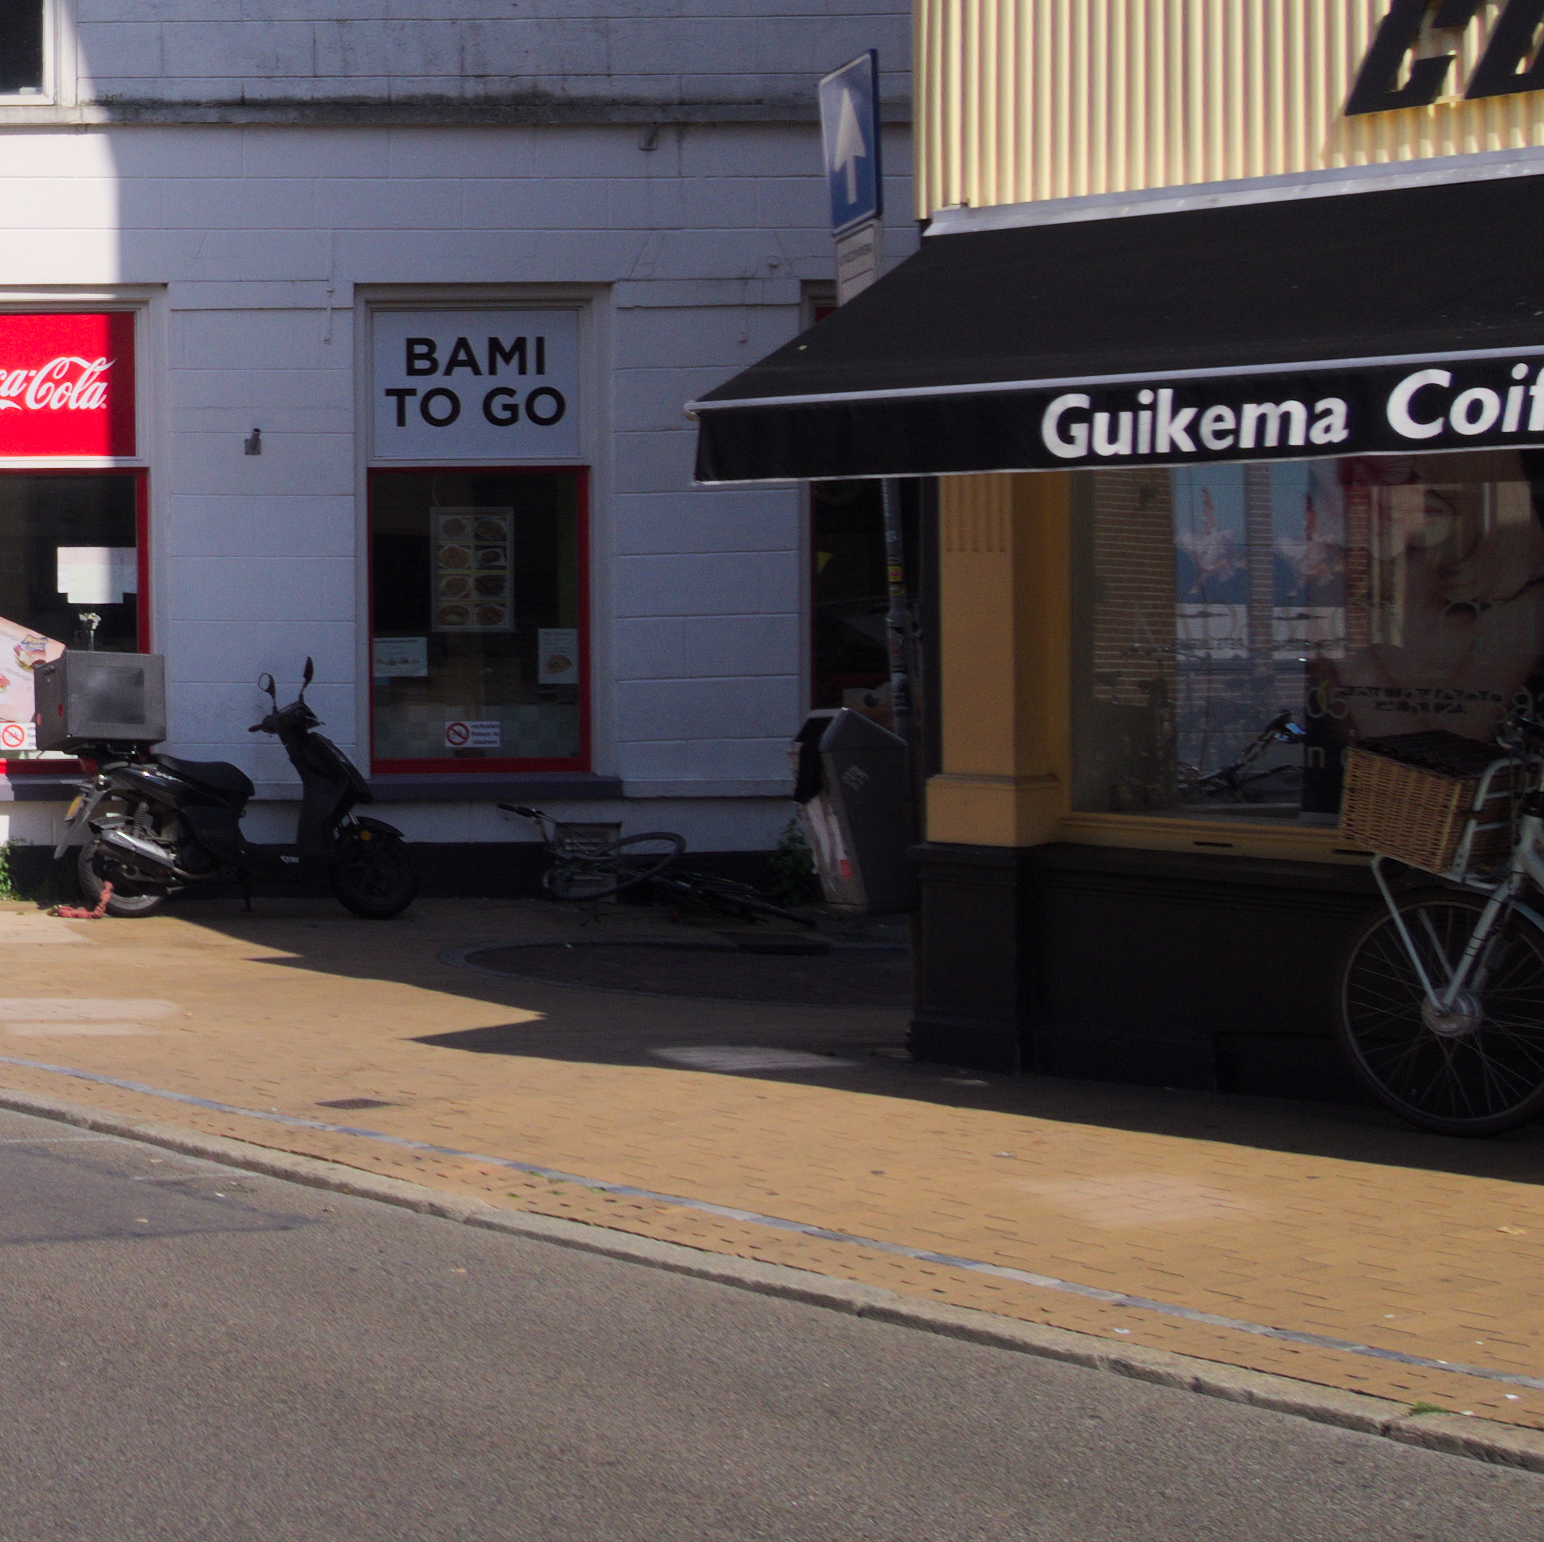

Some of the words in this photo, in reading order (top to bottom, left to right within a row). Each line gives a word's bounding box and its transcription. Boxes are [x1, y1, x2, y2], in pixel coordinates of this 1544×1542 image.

[406, 336, 545, 376] BAMI
[385, 387, 461, 427] TO
[482, 386, 566, 427] GO
[1041, 388, 1349, 459] Guikema
